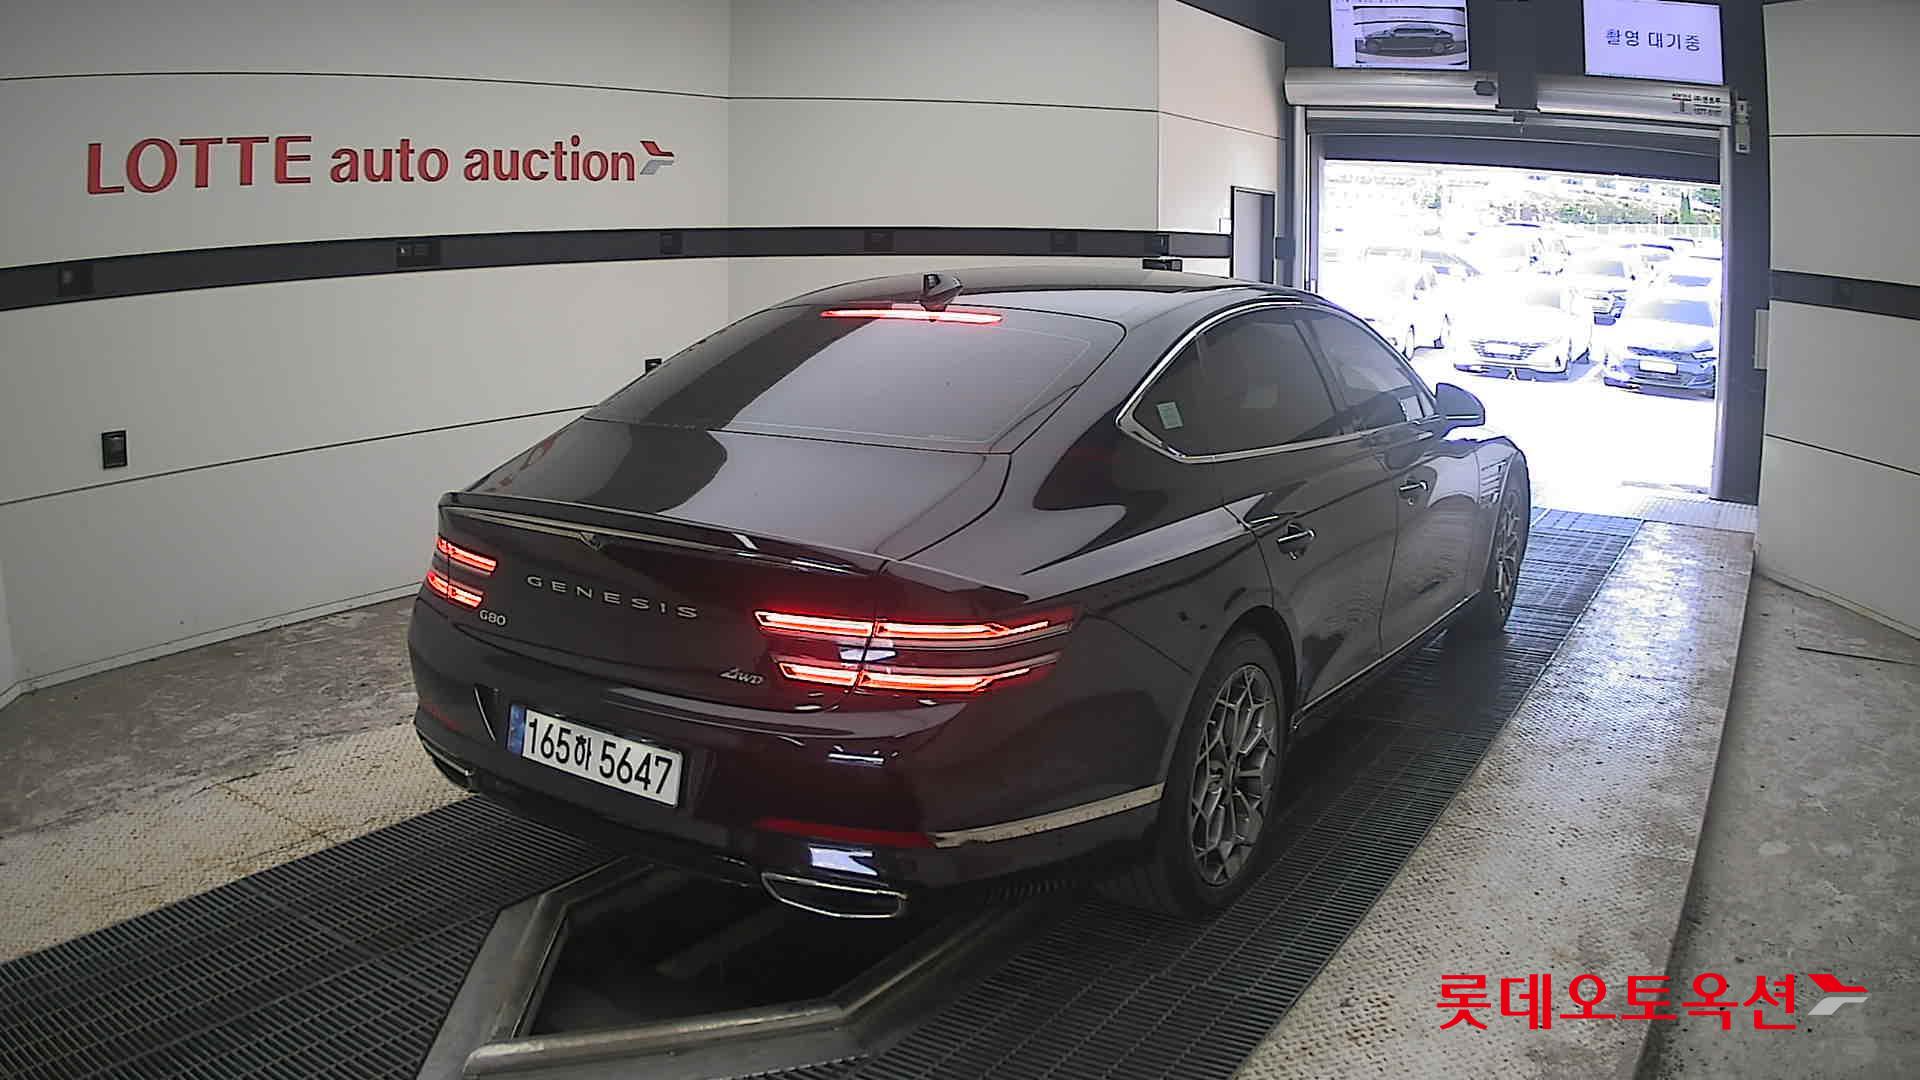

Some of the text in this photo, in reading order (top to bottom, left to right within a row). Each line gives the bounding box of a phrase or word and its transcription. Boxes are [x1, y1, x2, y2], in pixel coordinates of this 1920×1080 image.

[1648, 31, 1700, 51] 대기중
[86, 134, 636, 195] LOTTE auto auction
[479, 608, 507, 627] G80
[526, 575, 698, 619] GENESIS
[528, 717, 673, 794] 165하 5647
